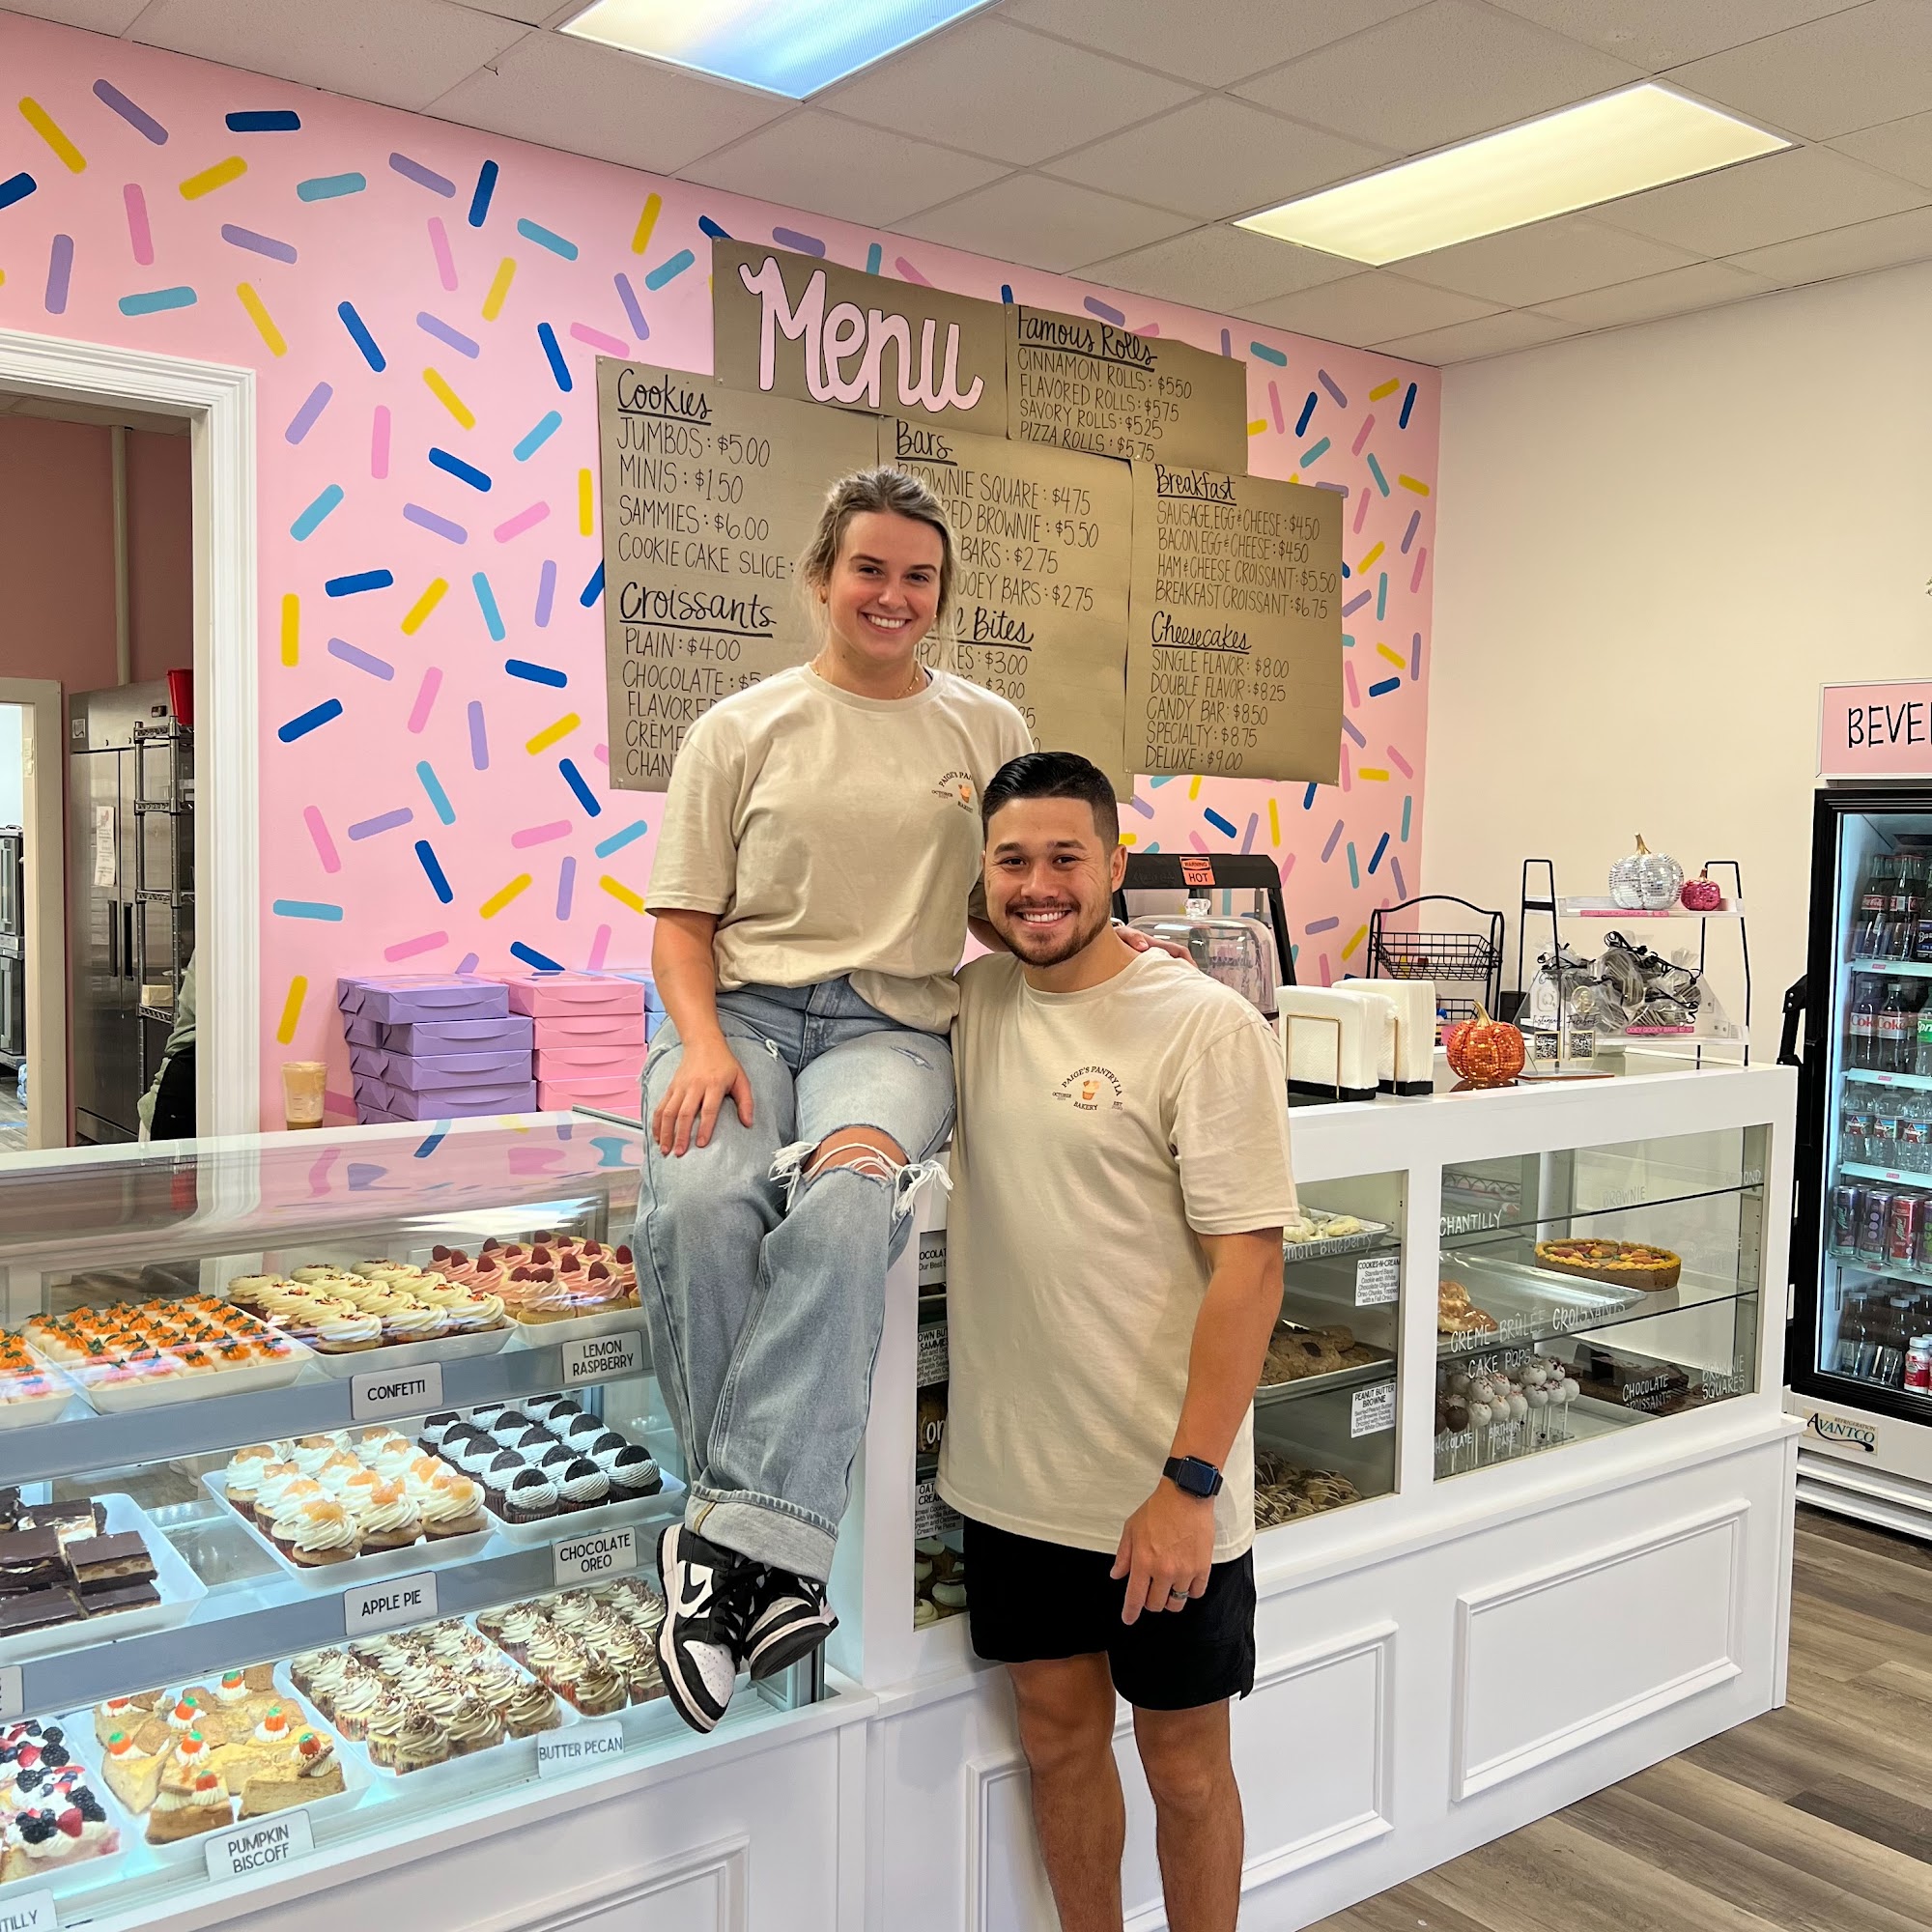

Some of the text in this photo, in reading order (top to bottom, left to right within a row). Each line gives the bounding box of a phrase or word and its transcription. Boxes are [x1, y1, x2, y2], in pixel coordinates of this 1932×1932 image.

[738, 255, 984, 413] Menu
[1017, 304, 1157, 365] Famous Rolls
[1017, 348, 1100, 382] CINNAMON
[617, 368, 713, 419] Cookies
[1020, 374, 1091, 406] FLAVORED
[1019, 398, 1072, 425] SAVORY
[895, 419, 953, 459] Bars
[1020, 420, 1057, 445] PIZZA
[695, 469, 743, 504] $1.50
[1155, 463, 1236, 500] Breakfast
[714, 513, 769, 541] $6.00
[1214, 505, 1236, 530] EGG
[1055, 520, 1099, 548] $5.50
[1201, 531, 1222, 555] EGG
[618, 532, 679, 567] COOKIE
[685, 542, 729, 573] CAKE
[1158, 553, 1181, 579] HAM
[1190, 555, 1231, 583] CHEESE
[1300, 569, 1337, 594] $5.50
[619, 582, 777, 629] Croissants
[1154, 578, 1222, 610] BREAKFAST
[973, 606, 1035, 644] Bites
[1151, 611, 1252, 651] Cheesecakes
[1151, 648, 1198, 673] SINGLE
[1151, 672, 1200, 696] DOUBLE
[1146, 696, 1196, 721] CANDY
[1848, 701, 1932, 749] BEVE
[1188, 872, 1208, 883] HOT
[1061, 1065, 1123, 1096] PAIGE'S PANTRY LA
[1073, 1101, 1098, 1111] BAKERY
[1439, 1208, 1503, 1237] CHANTILLY
[1284, 1241, 1314, 1261] emon
[582, 1340, 623, 1359] LEMON
[1467, 1348, 1531, 1379] CAKE POPS
[573, 1353, 634, 1377] RASPBERRY
[367, 1379, 426, 1402] CONFETTI
[1363, 1394, 1386, 1408] BROWNIE
[1376, 1384, 1395, 1396] BUTTER
[1623, 1373, 1669, 1403] CHOCOLATE
[1702, 1374, 1746, 1401] SQUARES
[1806, 1412, 1875, 1445] AVANTCO
[1833, 1416, 1876, 1432] REFRIGERATION
[1435, 1432, 1473, 1455] HOCOLATE
[559, 1533, 631, 1562] CHOCOLATE
[581, 1554, 612, 1573] OREO
[361, 1589, 422, 1617] APPLE PIE
[539, 1737, 623, 1761] BUTTER PECAN
[227, 1824, 290, 1857] PUMPKIN
[233, 1846, 290, 1874] BISCOFF
[0, 1909, 38, 1932] TILLY
